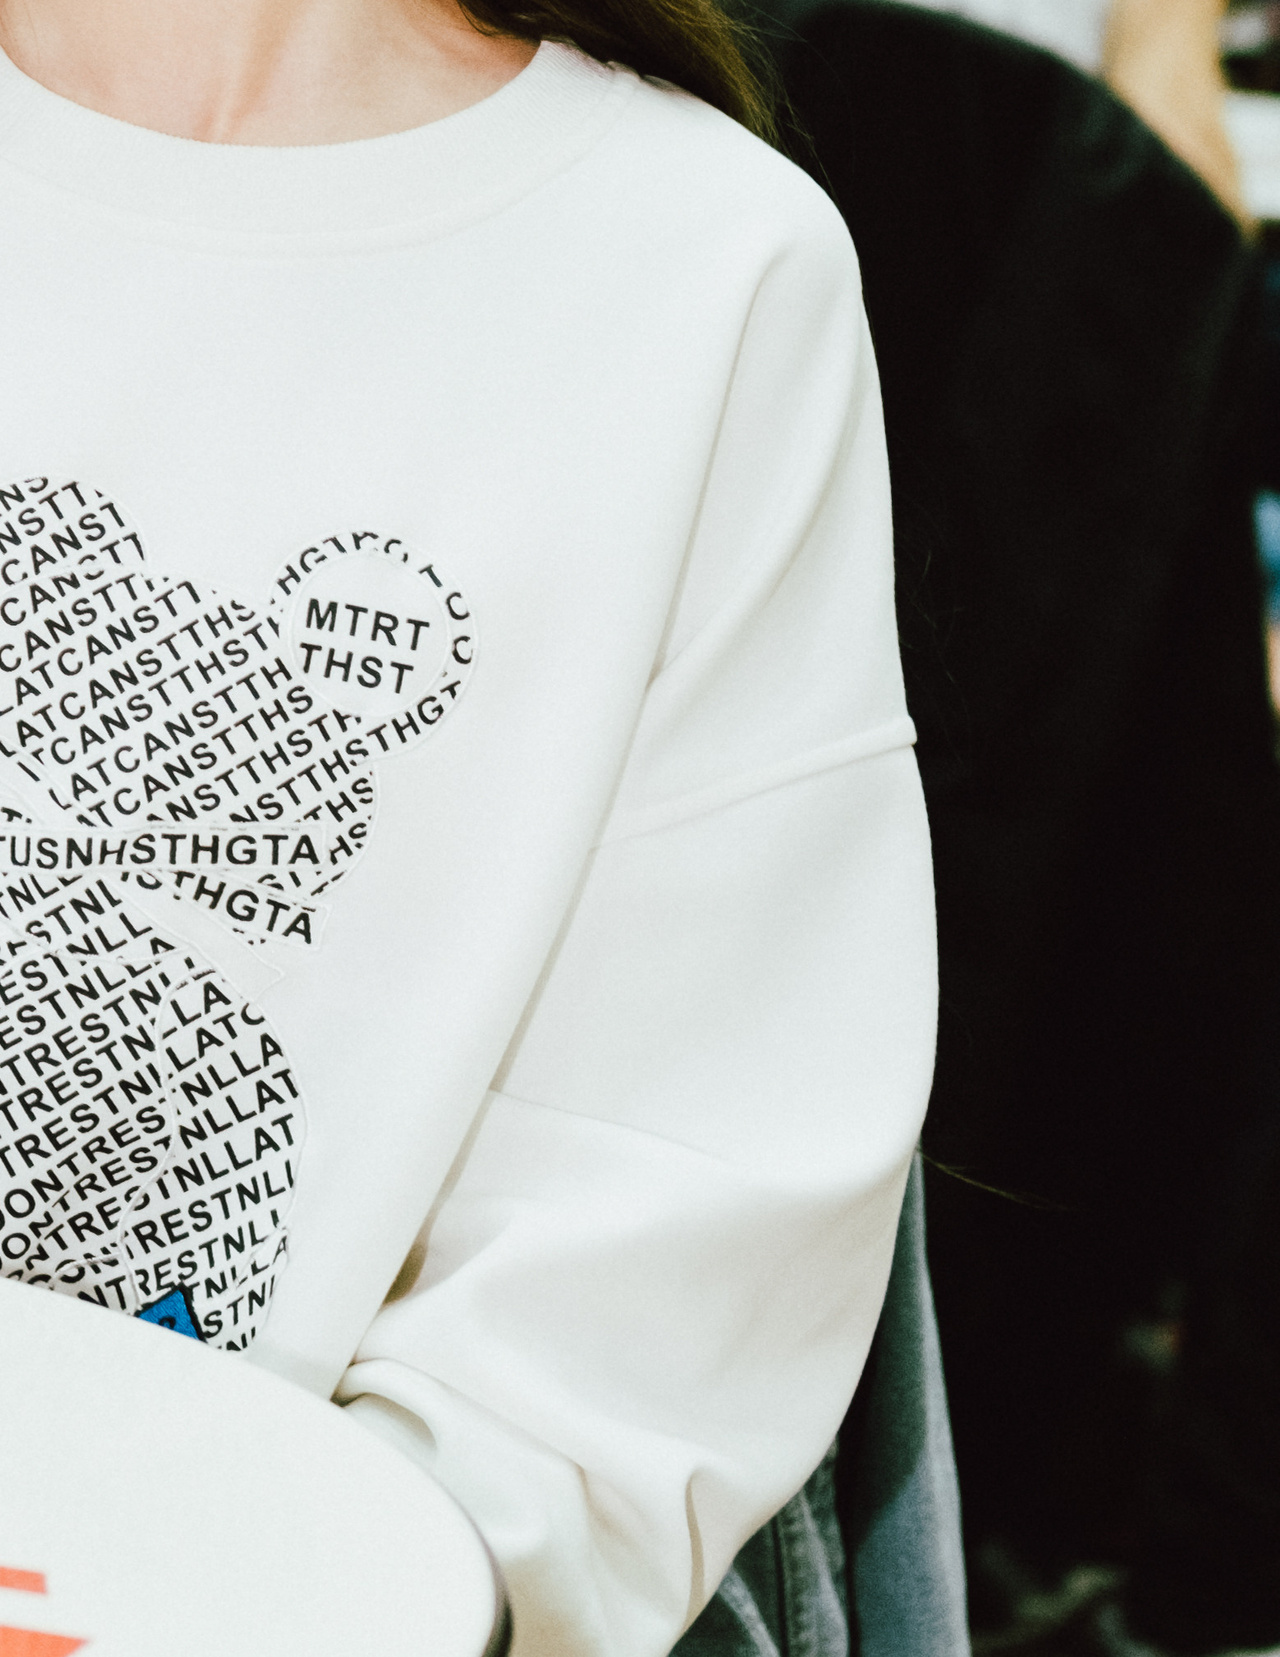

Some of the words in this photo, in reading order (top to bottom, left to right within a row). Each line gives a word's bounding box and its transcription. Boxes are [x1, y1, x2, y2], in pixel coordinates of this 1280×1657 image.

[306, 598, 430, 651] MTRT
[299, 642, 414, 694] THST
[146, 709, 362, 822] NSTTHSTH
